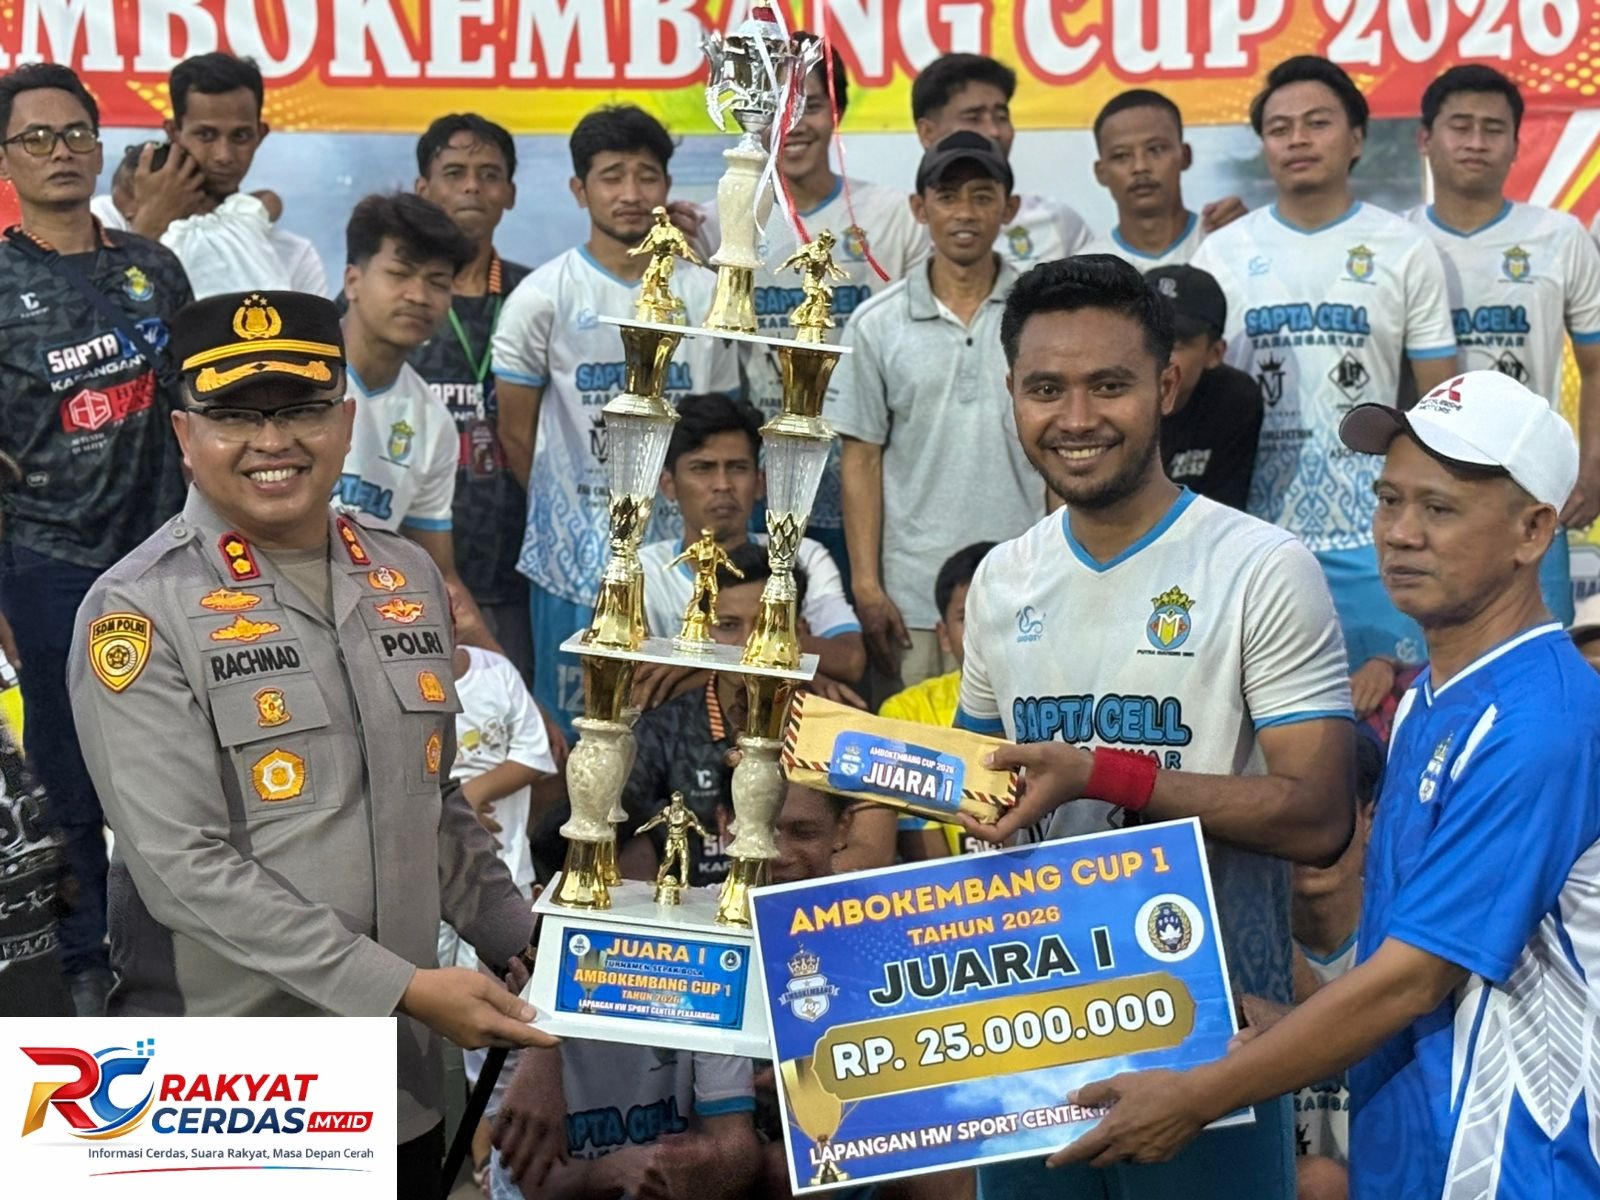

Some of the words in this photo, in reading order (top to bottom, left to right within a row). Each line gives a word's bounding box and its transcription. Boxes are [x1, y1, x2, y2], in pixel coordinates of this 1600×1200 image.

[1022, 0, 1283, 73] CUP
[1322, 0, 1580, 67] 2026
[1245, 303, 1313, 337] SAPTA
[1314, 303, 1370, 336] CELL
[1473, 305, 1531, 334] CELL
[47, 333, 119, 374] SAPTA
[95, 619, 115, 636] SDM
[117, 619, 145, 634] POLRI
[380, 633, 444, 658] POLRI
[210, 645, 300, 682] RACHMAD
[1013, 694, 1095, 744] SAPTA
[1094, 693, 1193, 747] CELL
[862, 761, 937, 799] JUARA
[922, 757, 936, 769] CUP
[788, 865, 1063, 936] AMBOKEMBANG
[1071, 856, 1143, 886] CUP
[1153, 846, 1170, 873] 1
[907, 916, 995, 946] TAHUN
[1002, 905, 1061, 931] 2026
[606, 938, 690, 963] JUARA
[573, 969, 688, 993] AMBOKEMBANG
[691, 980, 721, 996] CUP
[724, 983, 732, 998] 1
[869, 935, 1080, 1007] JUARA
[578, 998, 614, 1011] LAPANGAN
[627, 1003, 650, 1014] SPORT
[650, 1006, 676, 1016] CENTER
[622, 989, 653, 1001] TAHUN
[831, 1037, 907, 1081] RP.
[914, 988, 1175, 1067] 25.000.000
[810, 1130, 917, 1166] LAPANGAN
[920, 1124, 953, 1148] HW
[956, 1113, 1019, 1141] SPORT
